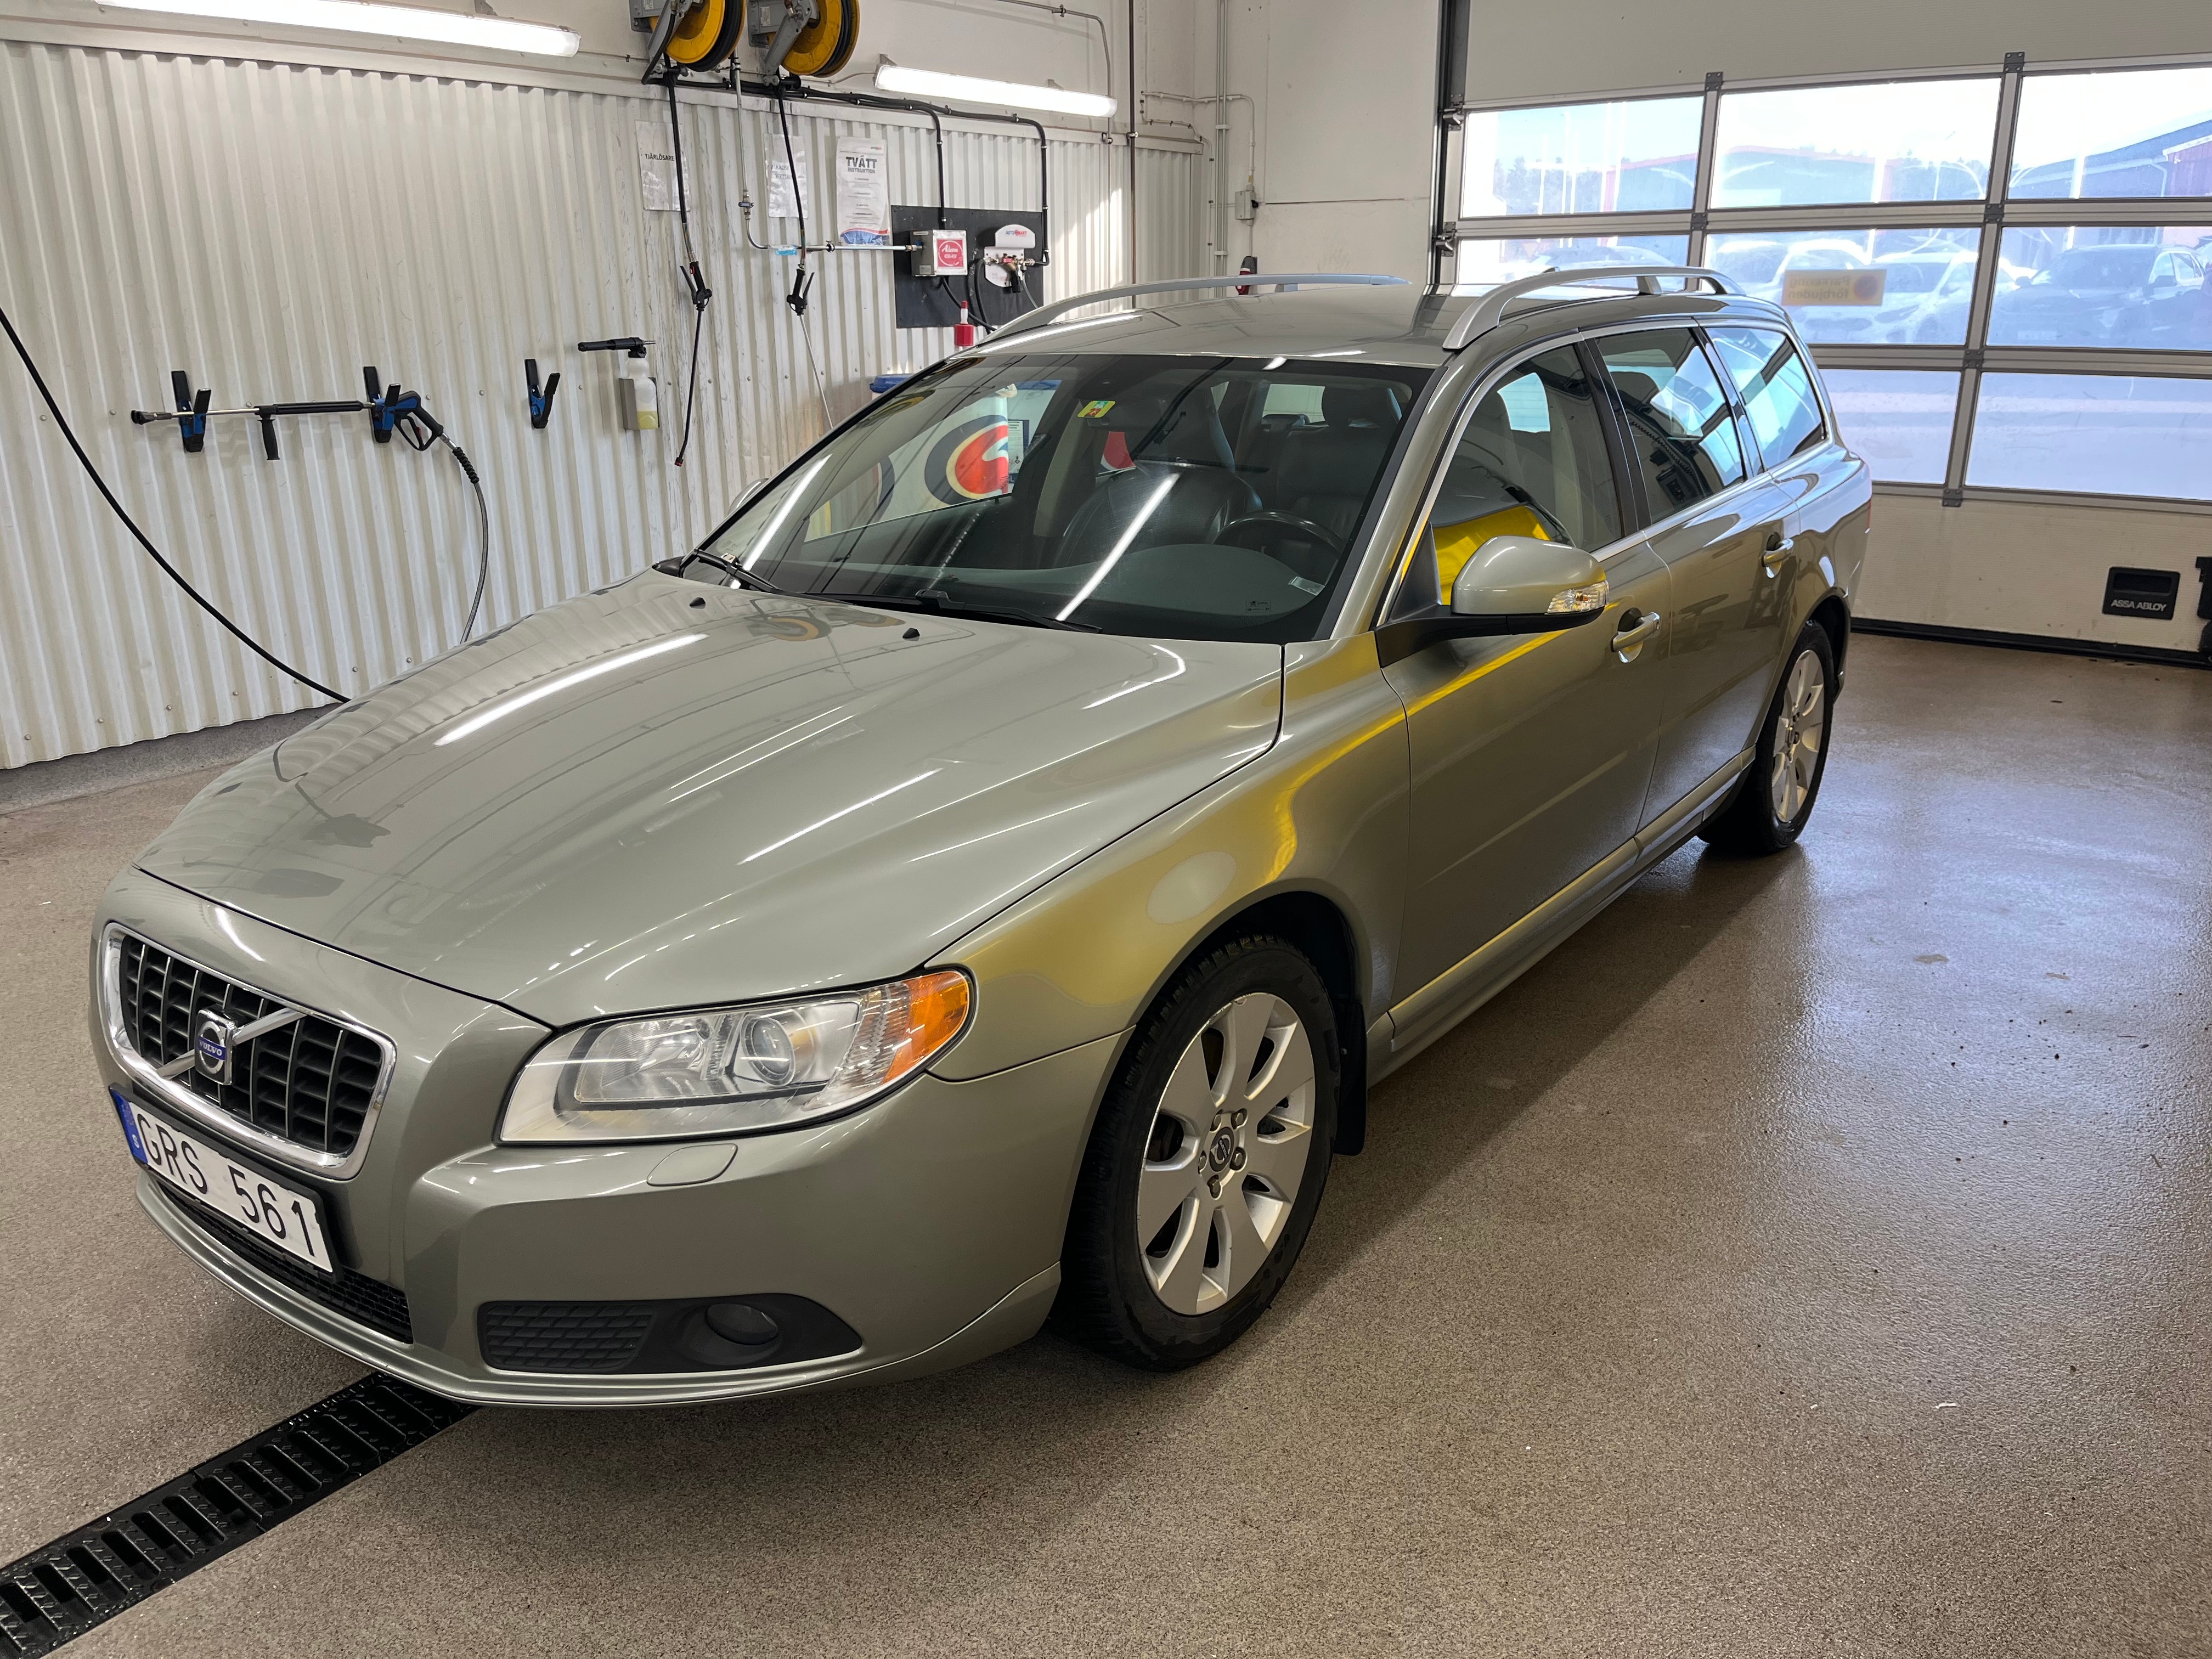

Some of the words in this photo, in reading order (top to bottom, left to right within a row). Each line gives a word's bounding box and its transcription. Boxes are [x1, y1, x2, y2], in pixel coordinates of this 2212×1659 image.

[645, 153, 675, 161] TJÄRLÖSARE
[2111, 599, 2135, 608] ASSA
[2136, 602, 2167, 611] ABLOY
[199, 1040, 222, 1056] VOLVO
[131, 1133, 140, 1148] S
[137, 1113, 208, 1194] GRS
[228, 1165, 315, 1257] 561
